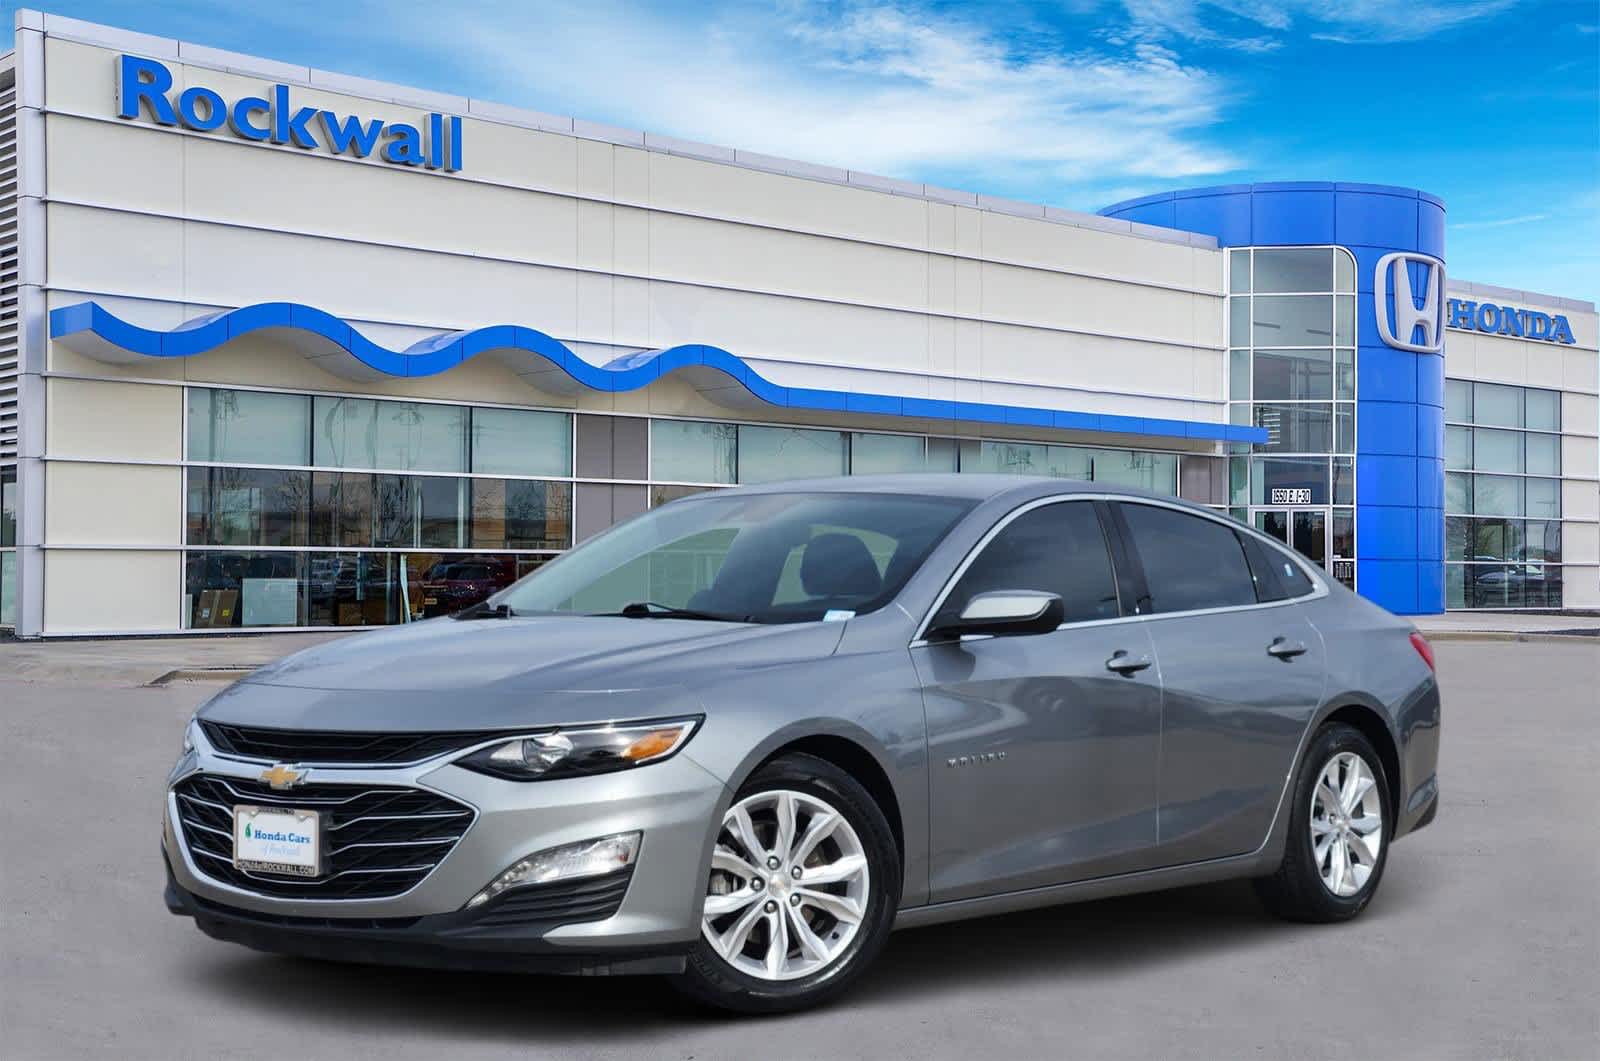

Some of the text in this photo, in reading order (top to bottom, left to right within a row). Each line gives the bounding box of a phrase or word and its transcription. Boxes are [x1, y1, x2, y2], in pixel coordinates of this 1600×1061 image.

[118, 54, 463, 172] Rockwall
[1447, 298, 1577, 344] HONDA
[1273, 490, 1288, 502] 1550
[255, 829, 311, 844] Honda Cars
